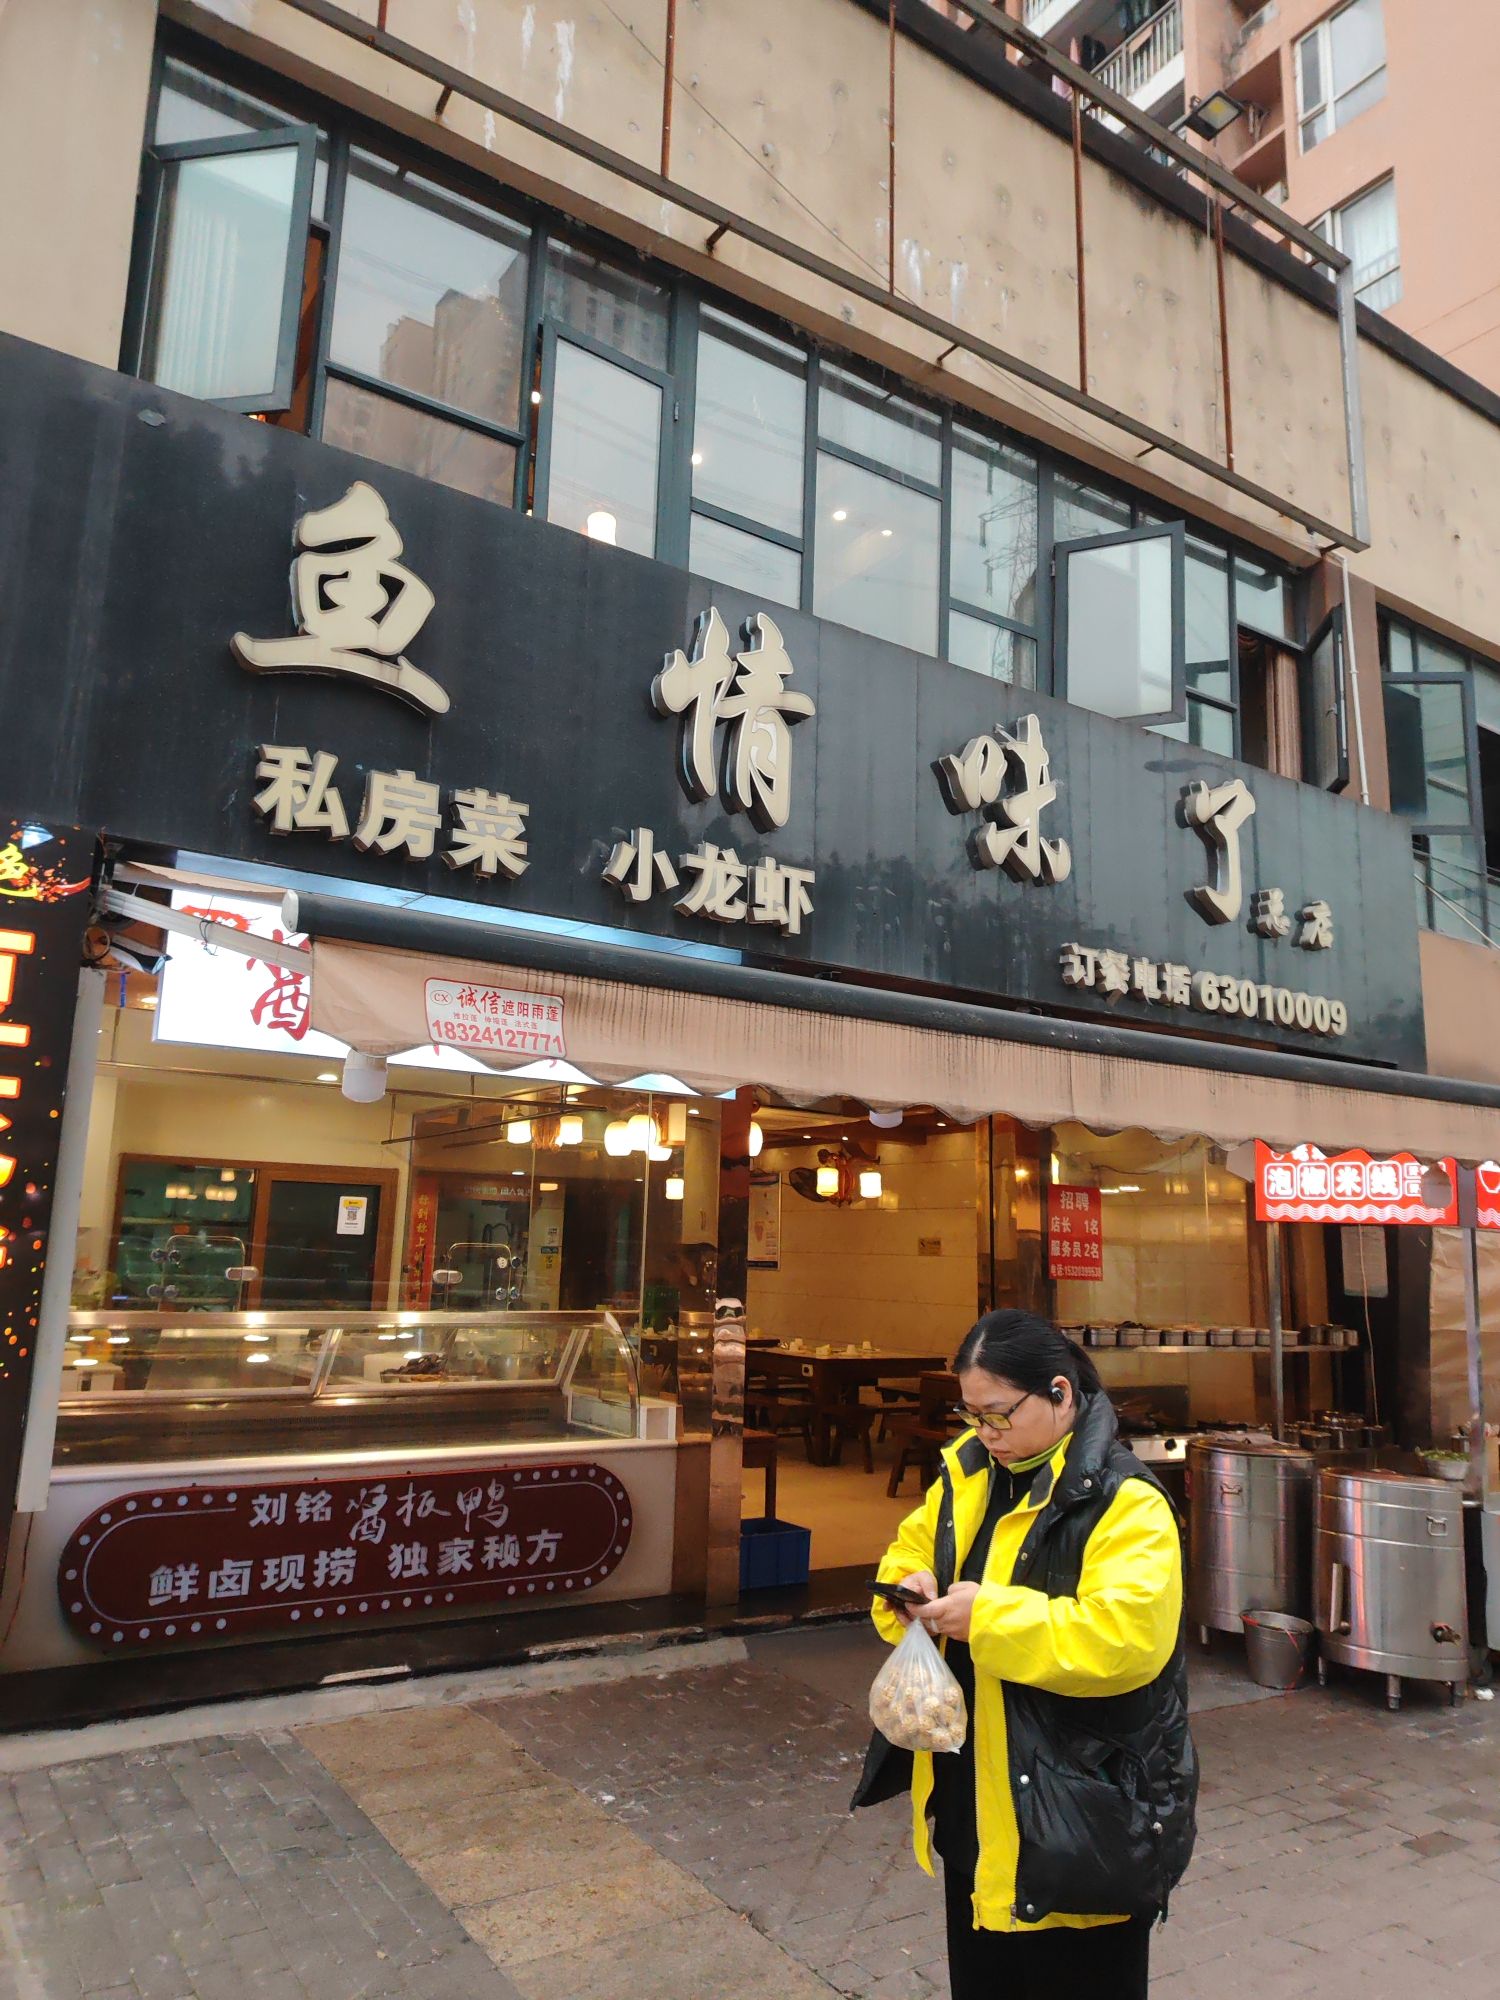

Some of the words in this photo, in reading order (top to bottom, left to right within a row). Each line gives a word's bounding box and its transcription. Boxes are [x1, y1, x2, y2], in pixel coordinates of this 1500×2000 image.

[251, 743, 530, 878] 私房菜
[601, 827, 816, 936] 小龙虾
[1059, 943, 1192, 1006] 订餐电话
[1196, 970, 1348, 1036] 63010009
[432, 1019, 563, 1053] 18324127771
[1050, 1215, 1072, 1233] 店长
[1060, 1190, 1089, 1212] 招聘
[148, 1547, 357, 1606] 鲜卤现捞
[387, 1529, 563, 1580] 独家秘方
